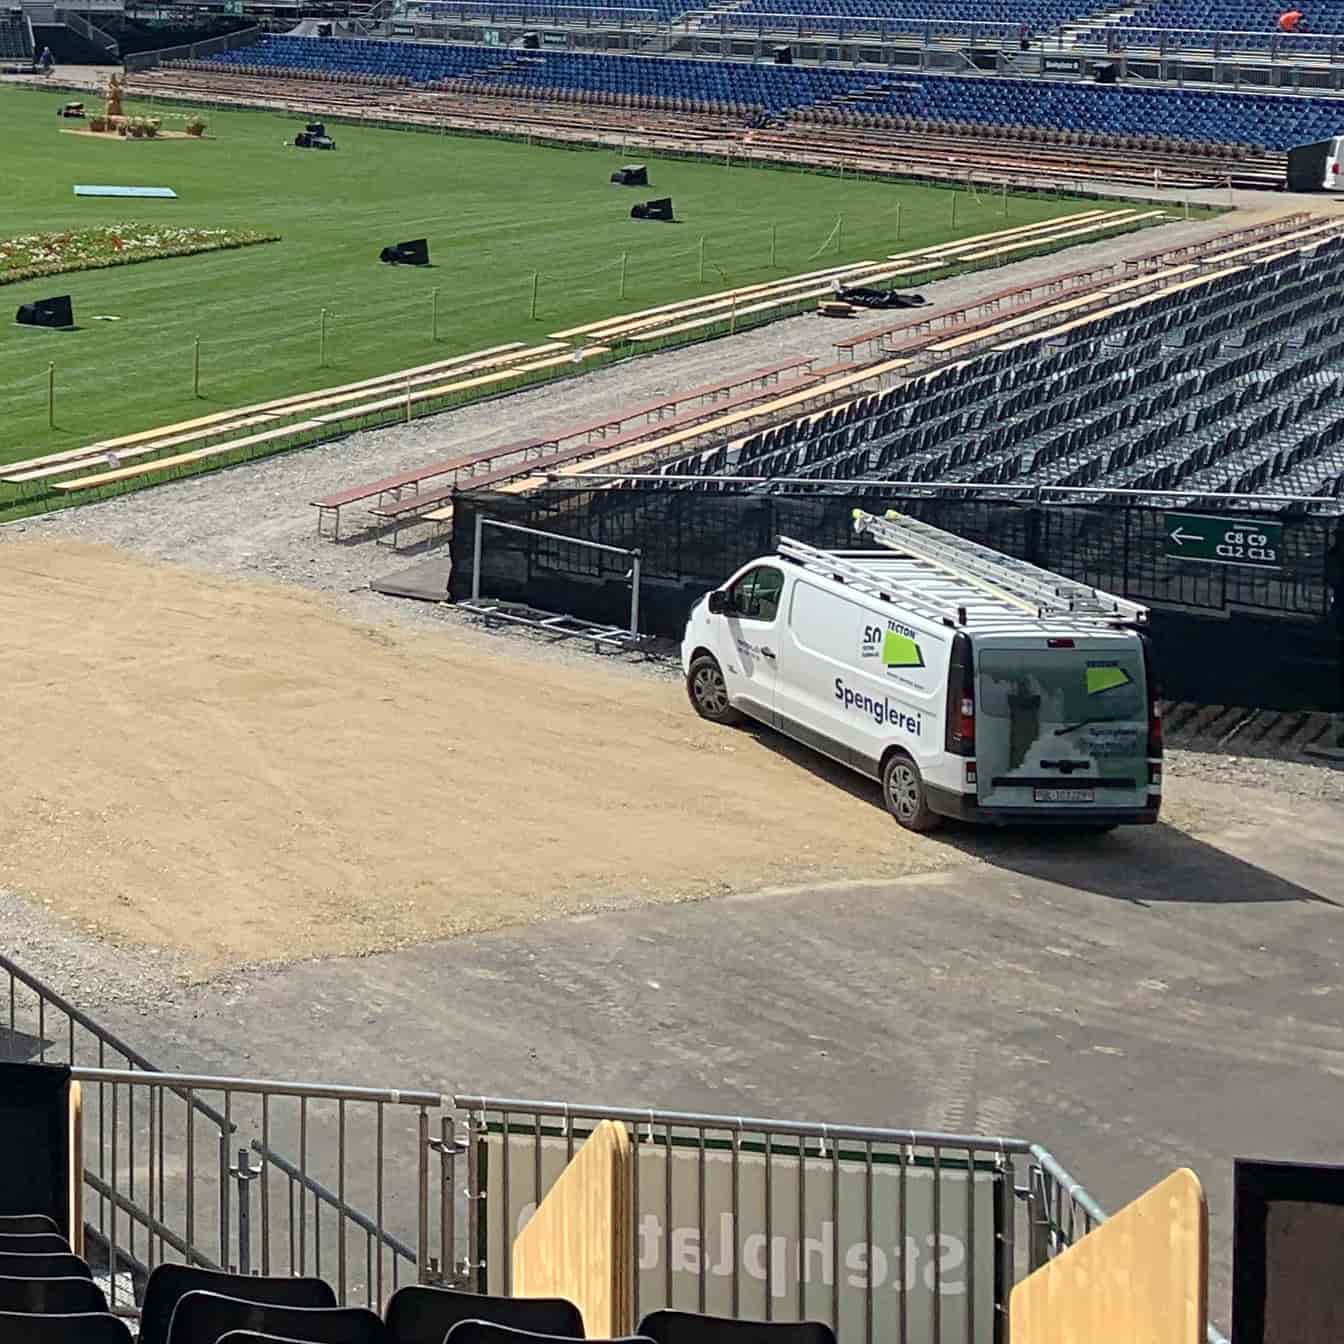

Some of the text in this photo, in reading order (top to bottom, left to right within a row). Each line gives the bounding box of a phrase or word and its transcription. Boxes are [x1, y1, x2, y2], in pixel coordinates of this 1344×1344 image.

[1224, 531, 1268, 547] C8 C9
[1216, 544, 1276, 561] C12 C13
[835, 677, 921, 736] Spenglerei
